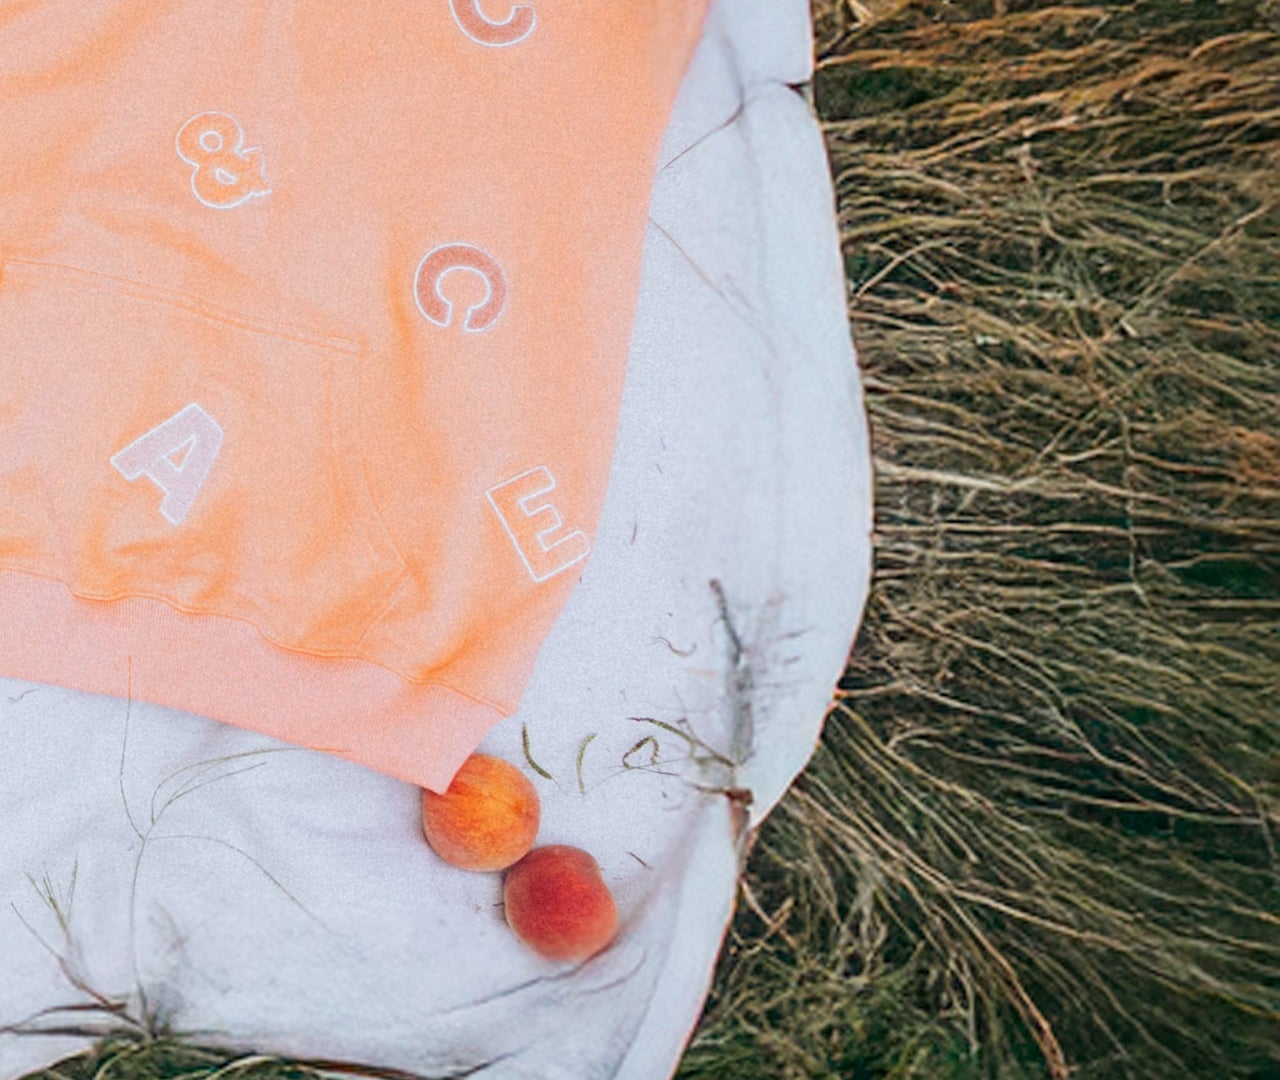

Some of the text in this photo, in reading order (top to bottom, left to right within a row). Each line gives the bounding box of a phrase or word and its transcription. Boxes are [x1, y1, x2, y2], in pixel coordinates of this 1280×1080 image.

[176, 111, 271, 208] &
[414, 242, 509, 332] C
[109, 402, 224, 526] A
[486, 465, 591, 582] E
